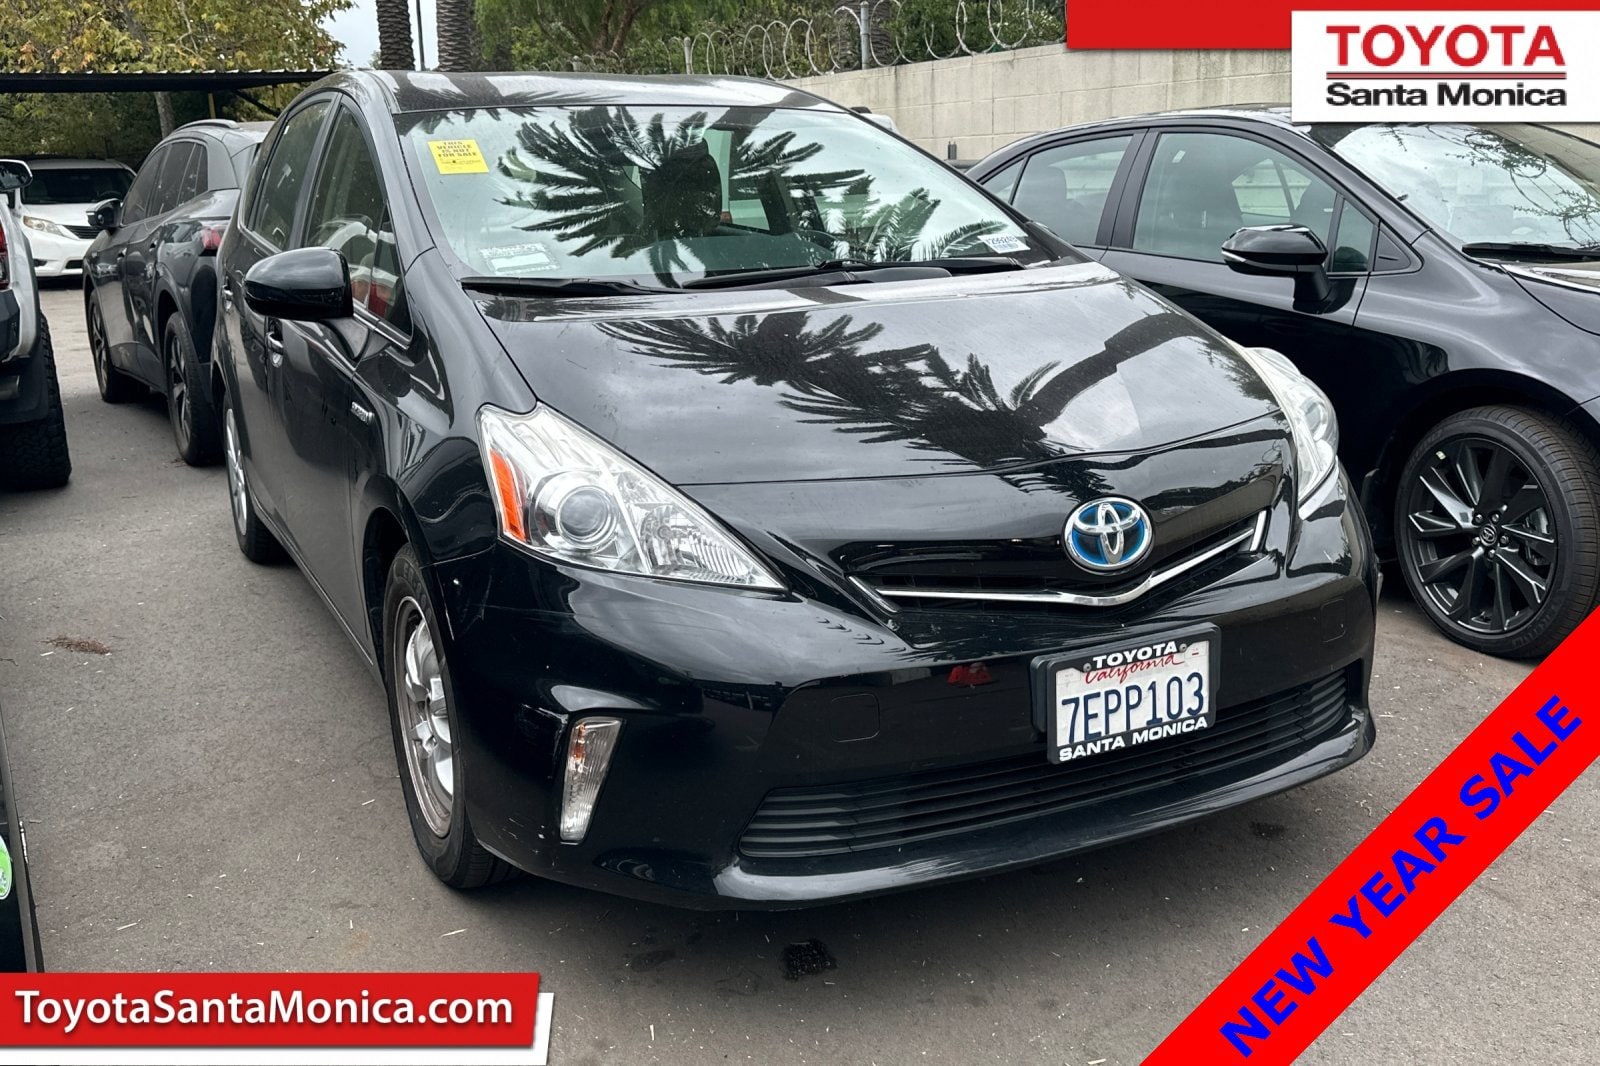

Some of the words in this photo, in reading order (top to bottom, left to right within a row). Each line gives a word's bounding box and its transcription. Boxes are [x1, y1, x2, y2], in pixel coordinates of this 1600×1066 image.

[1084, 653, 1185, 684] California
[1092, 641, 1178, 669] TOYOTA
[1061, 671, 1204, 745] 7EPP103
[1059, 738, 1125, 762] SANTA
[1132, 717, 1208, 745] MONICA
